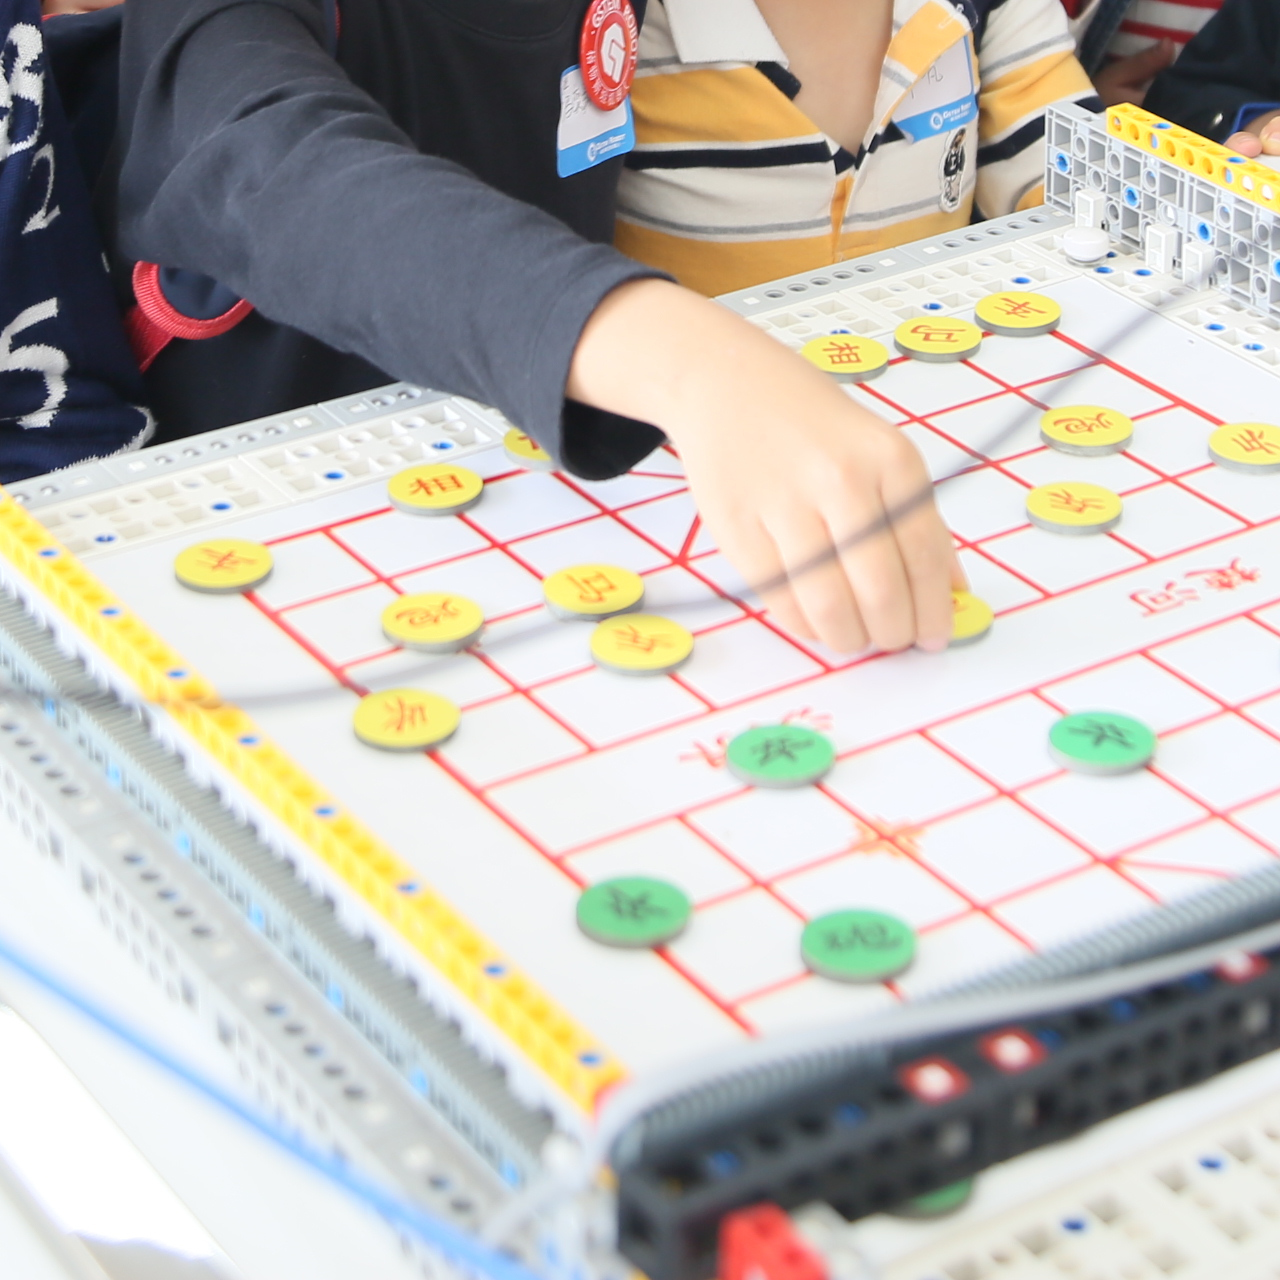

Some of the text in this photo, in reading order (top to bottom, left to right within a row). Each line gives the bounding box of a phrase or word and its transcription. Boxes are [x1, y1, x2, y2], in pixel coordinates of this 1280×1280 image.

[822, 341, 862, 366] 相
[1053, 411, 1114, 435] 炮
[409, 474, 464, 496] 相
